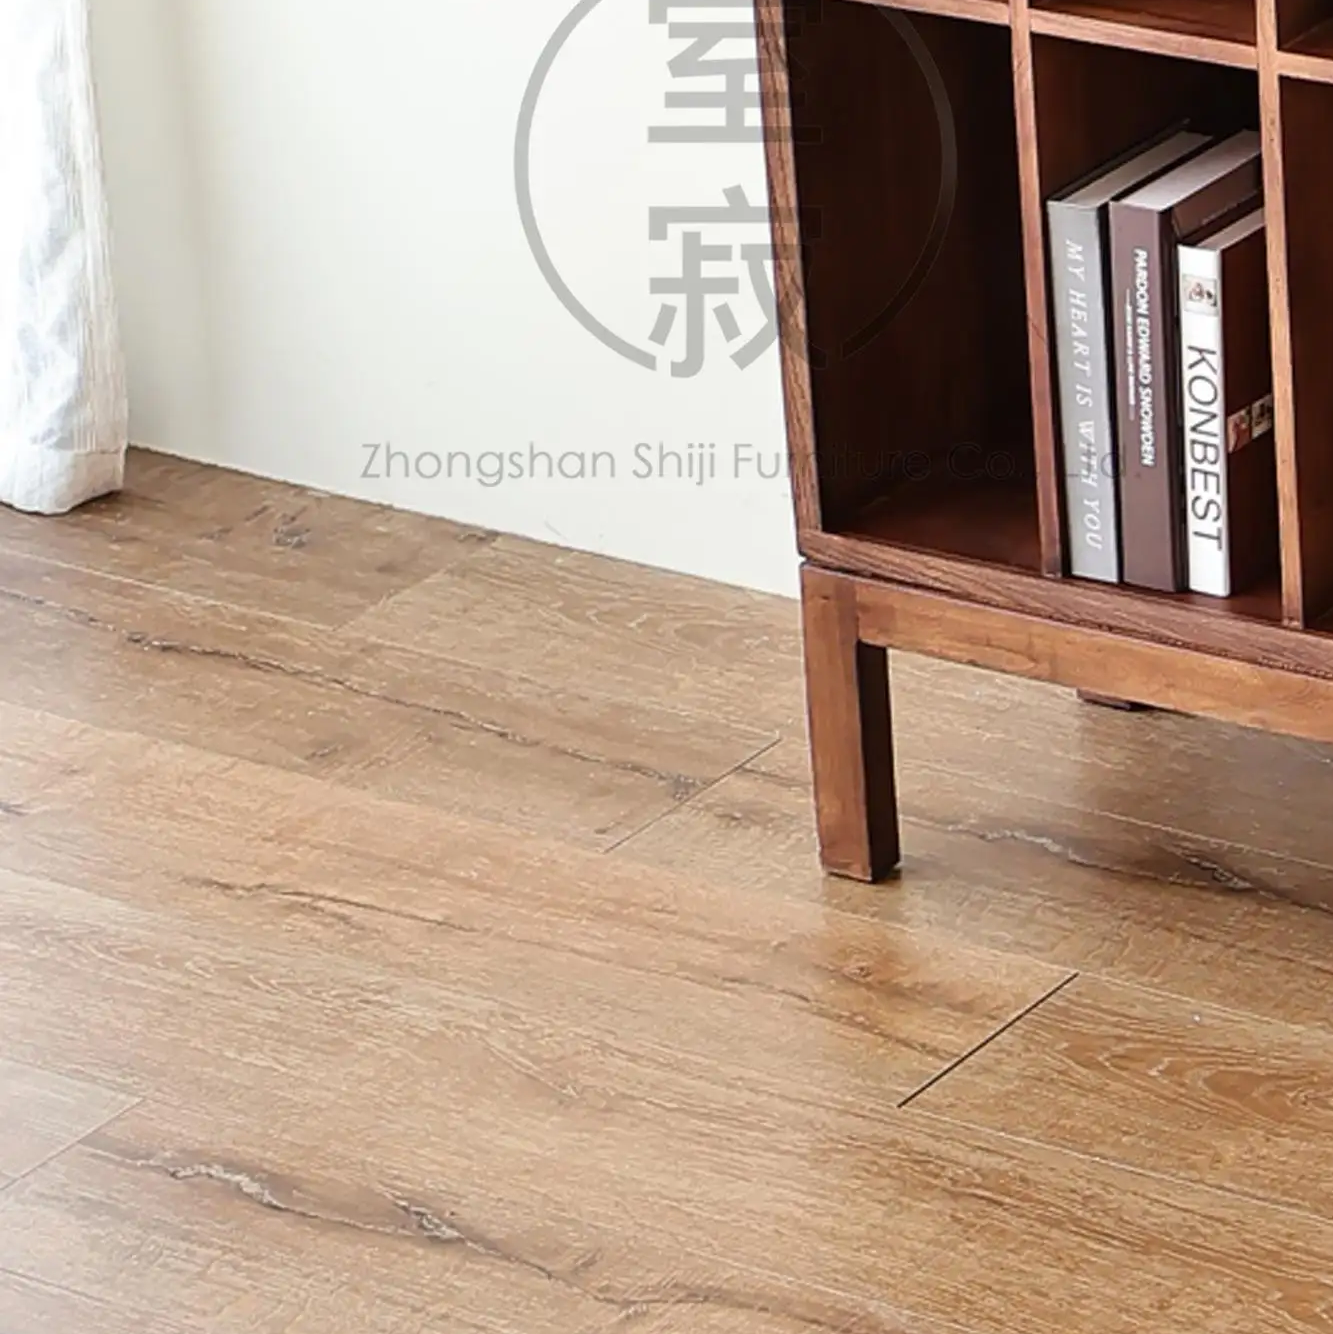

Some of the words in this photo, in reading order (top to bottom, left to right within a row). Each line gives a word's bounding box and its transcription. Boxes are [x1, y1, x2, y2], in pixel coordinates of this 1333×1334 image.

[1064, 238, 1087, 281] MY
[1132, 247, 1150, 315] PARDON
[1067, 287, 1094, 378] HEART
[1136, 316, 1153, 385] EDWARD
[1075, 382, 1095, 408] IS
[1139, 385, 1156, 468] SNOWDEN
[1077, 420, 1099, 486] WITH
[1187, 344, 1224, 552] KONBEST
[1082, 497, 1104, 551] YOU
